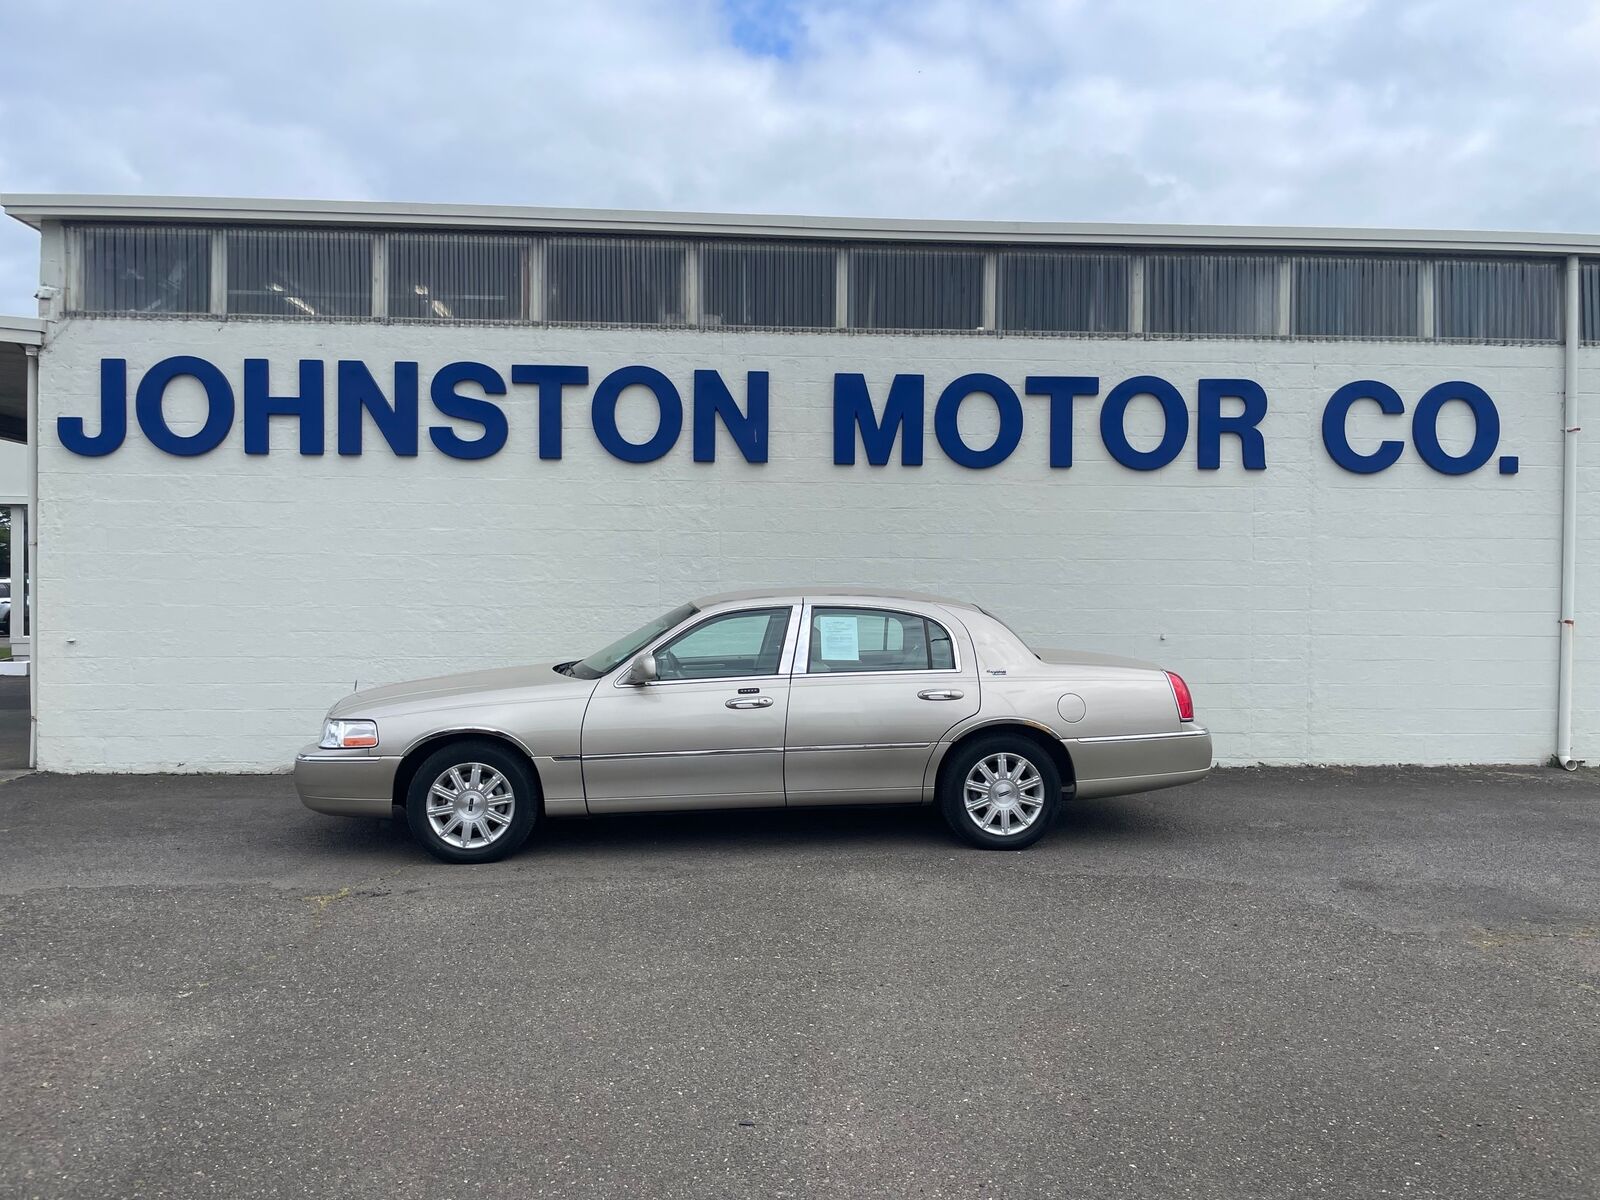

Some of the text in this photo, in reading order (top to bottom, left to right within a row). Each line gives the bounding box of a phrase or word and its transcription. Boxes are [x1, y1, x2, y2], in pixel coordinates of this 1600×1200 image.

[58, 356, 1518, 474] JOHNSTON MOTOR CO.
